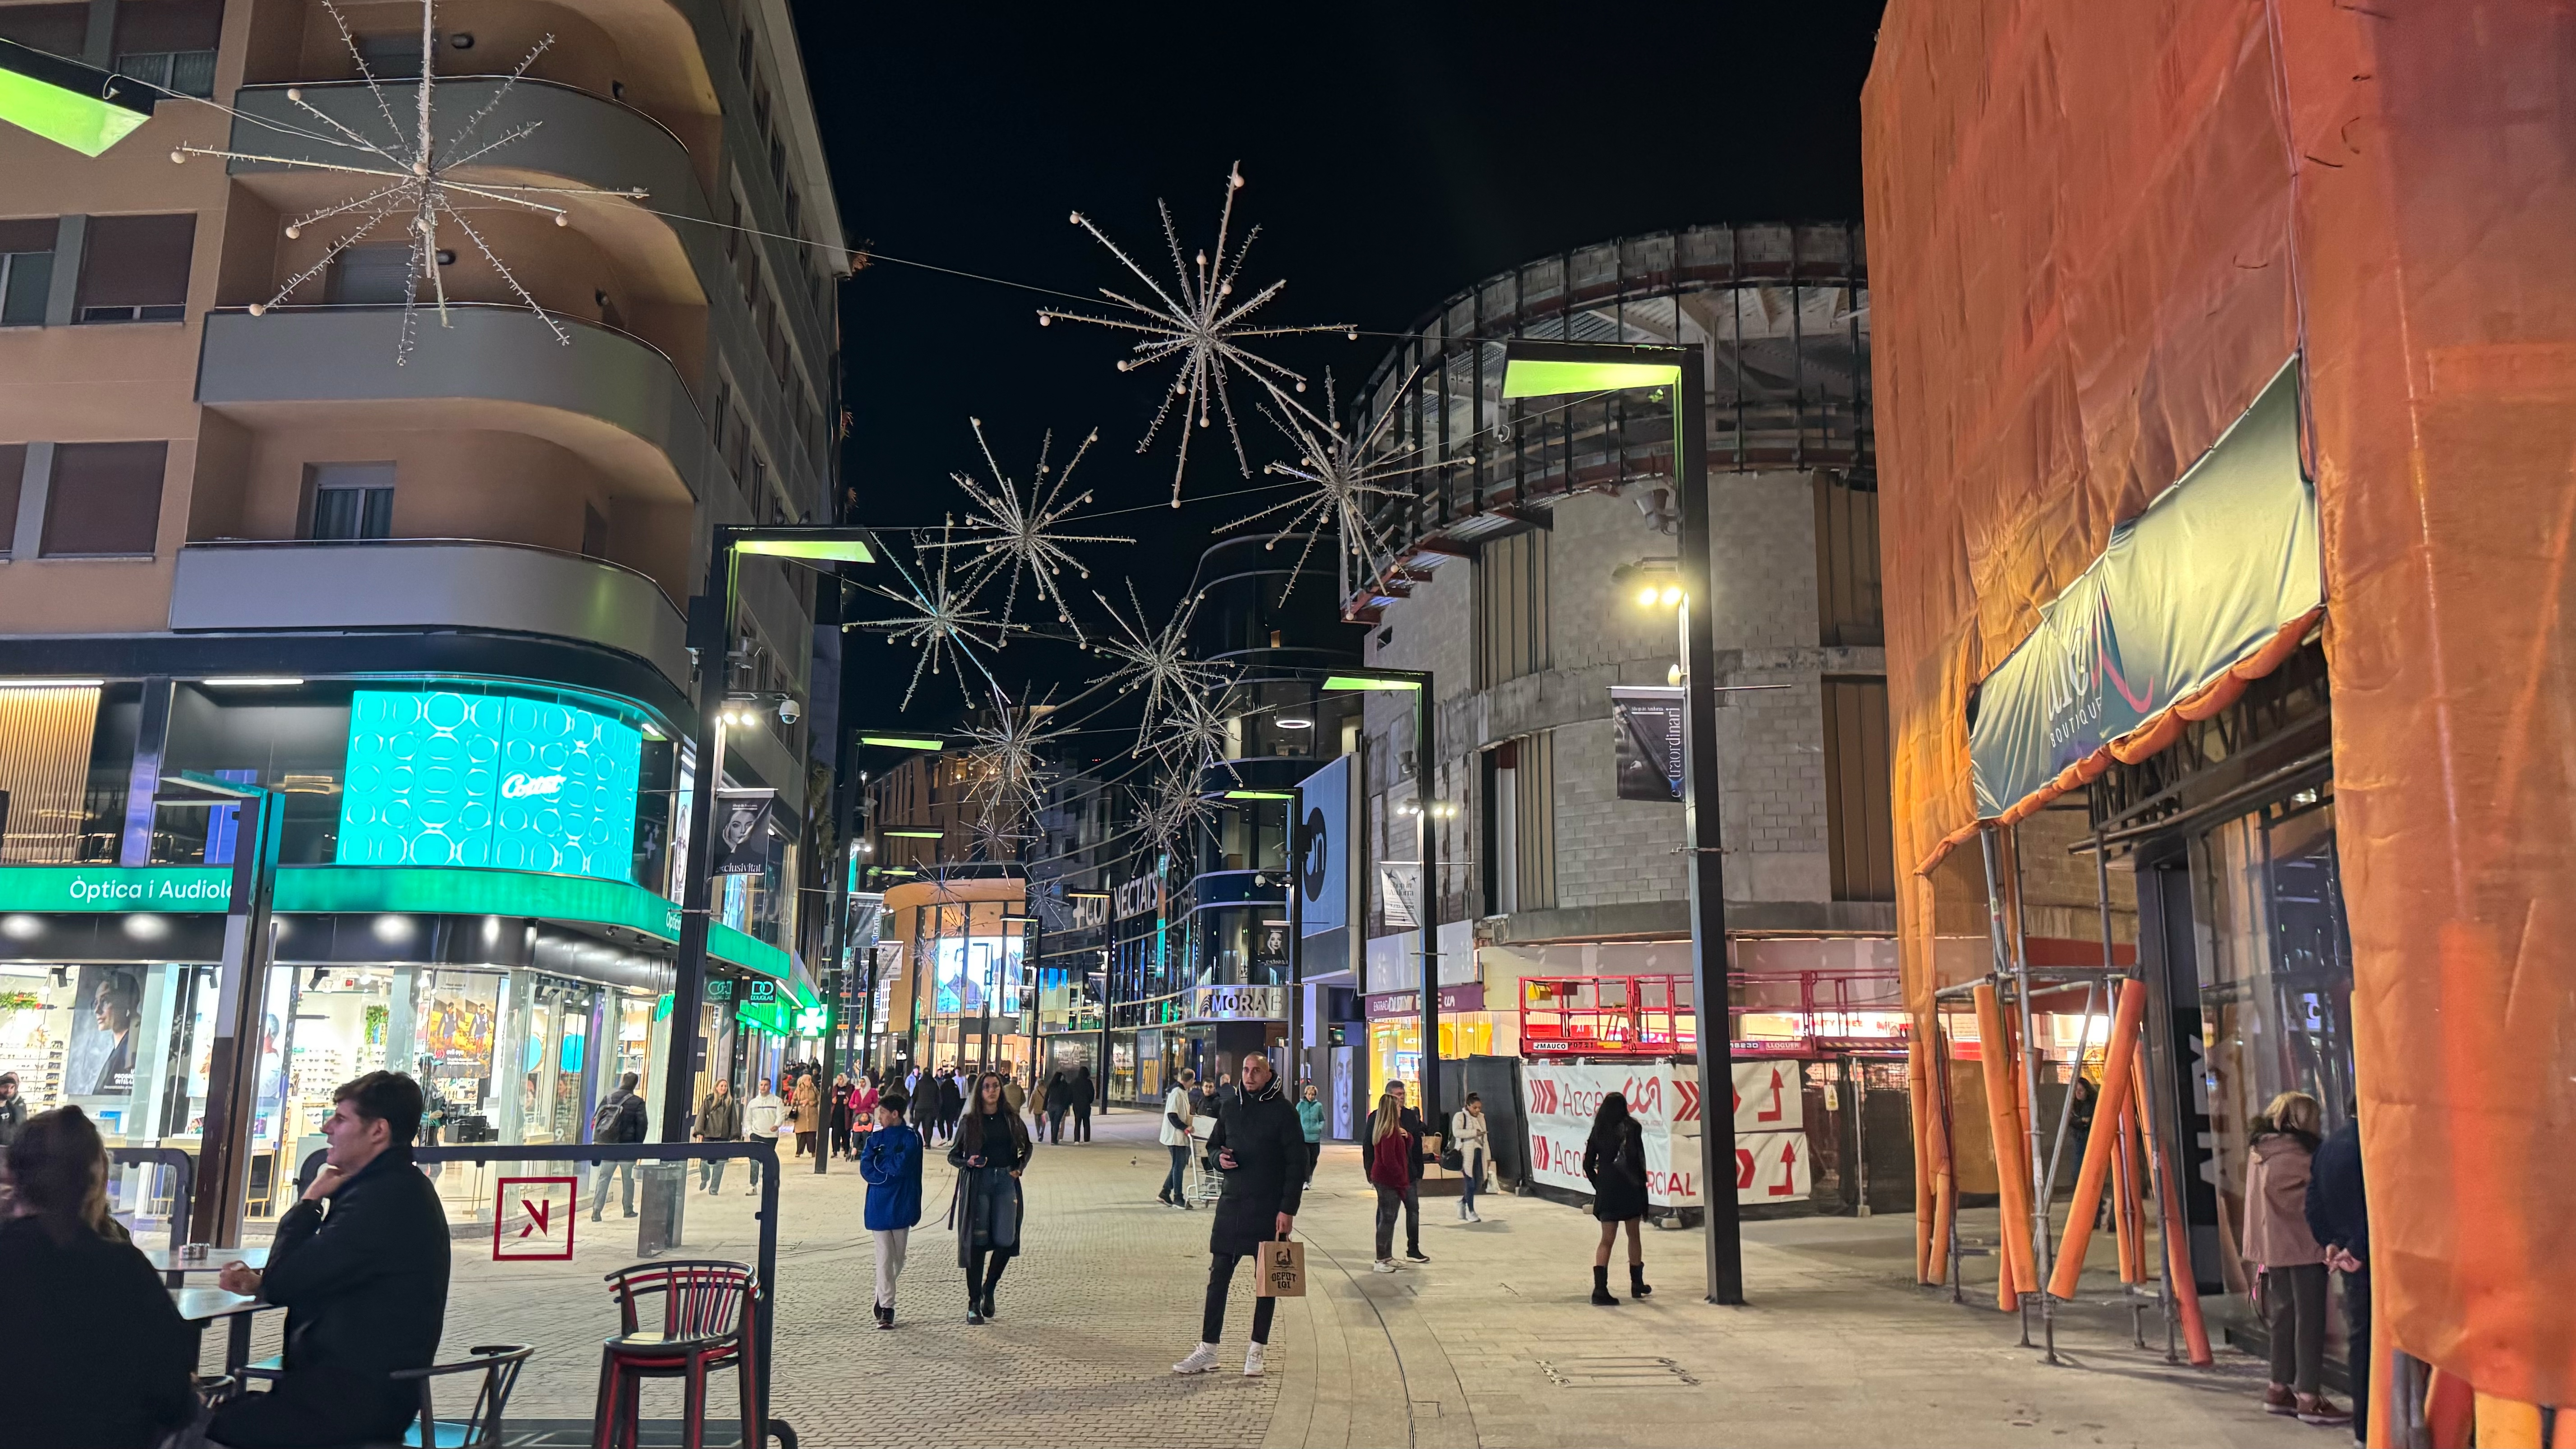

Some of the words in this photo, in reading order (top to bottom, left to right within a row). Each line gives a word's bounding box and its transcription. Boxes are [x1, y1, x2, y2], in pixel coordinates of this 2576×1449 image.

[69, 875, 143, 904] Òptica
[148, 879, 155, 898] i
[1389, 995, 1414, 1012] DUTY
